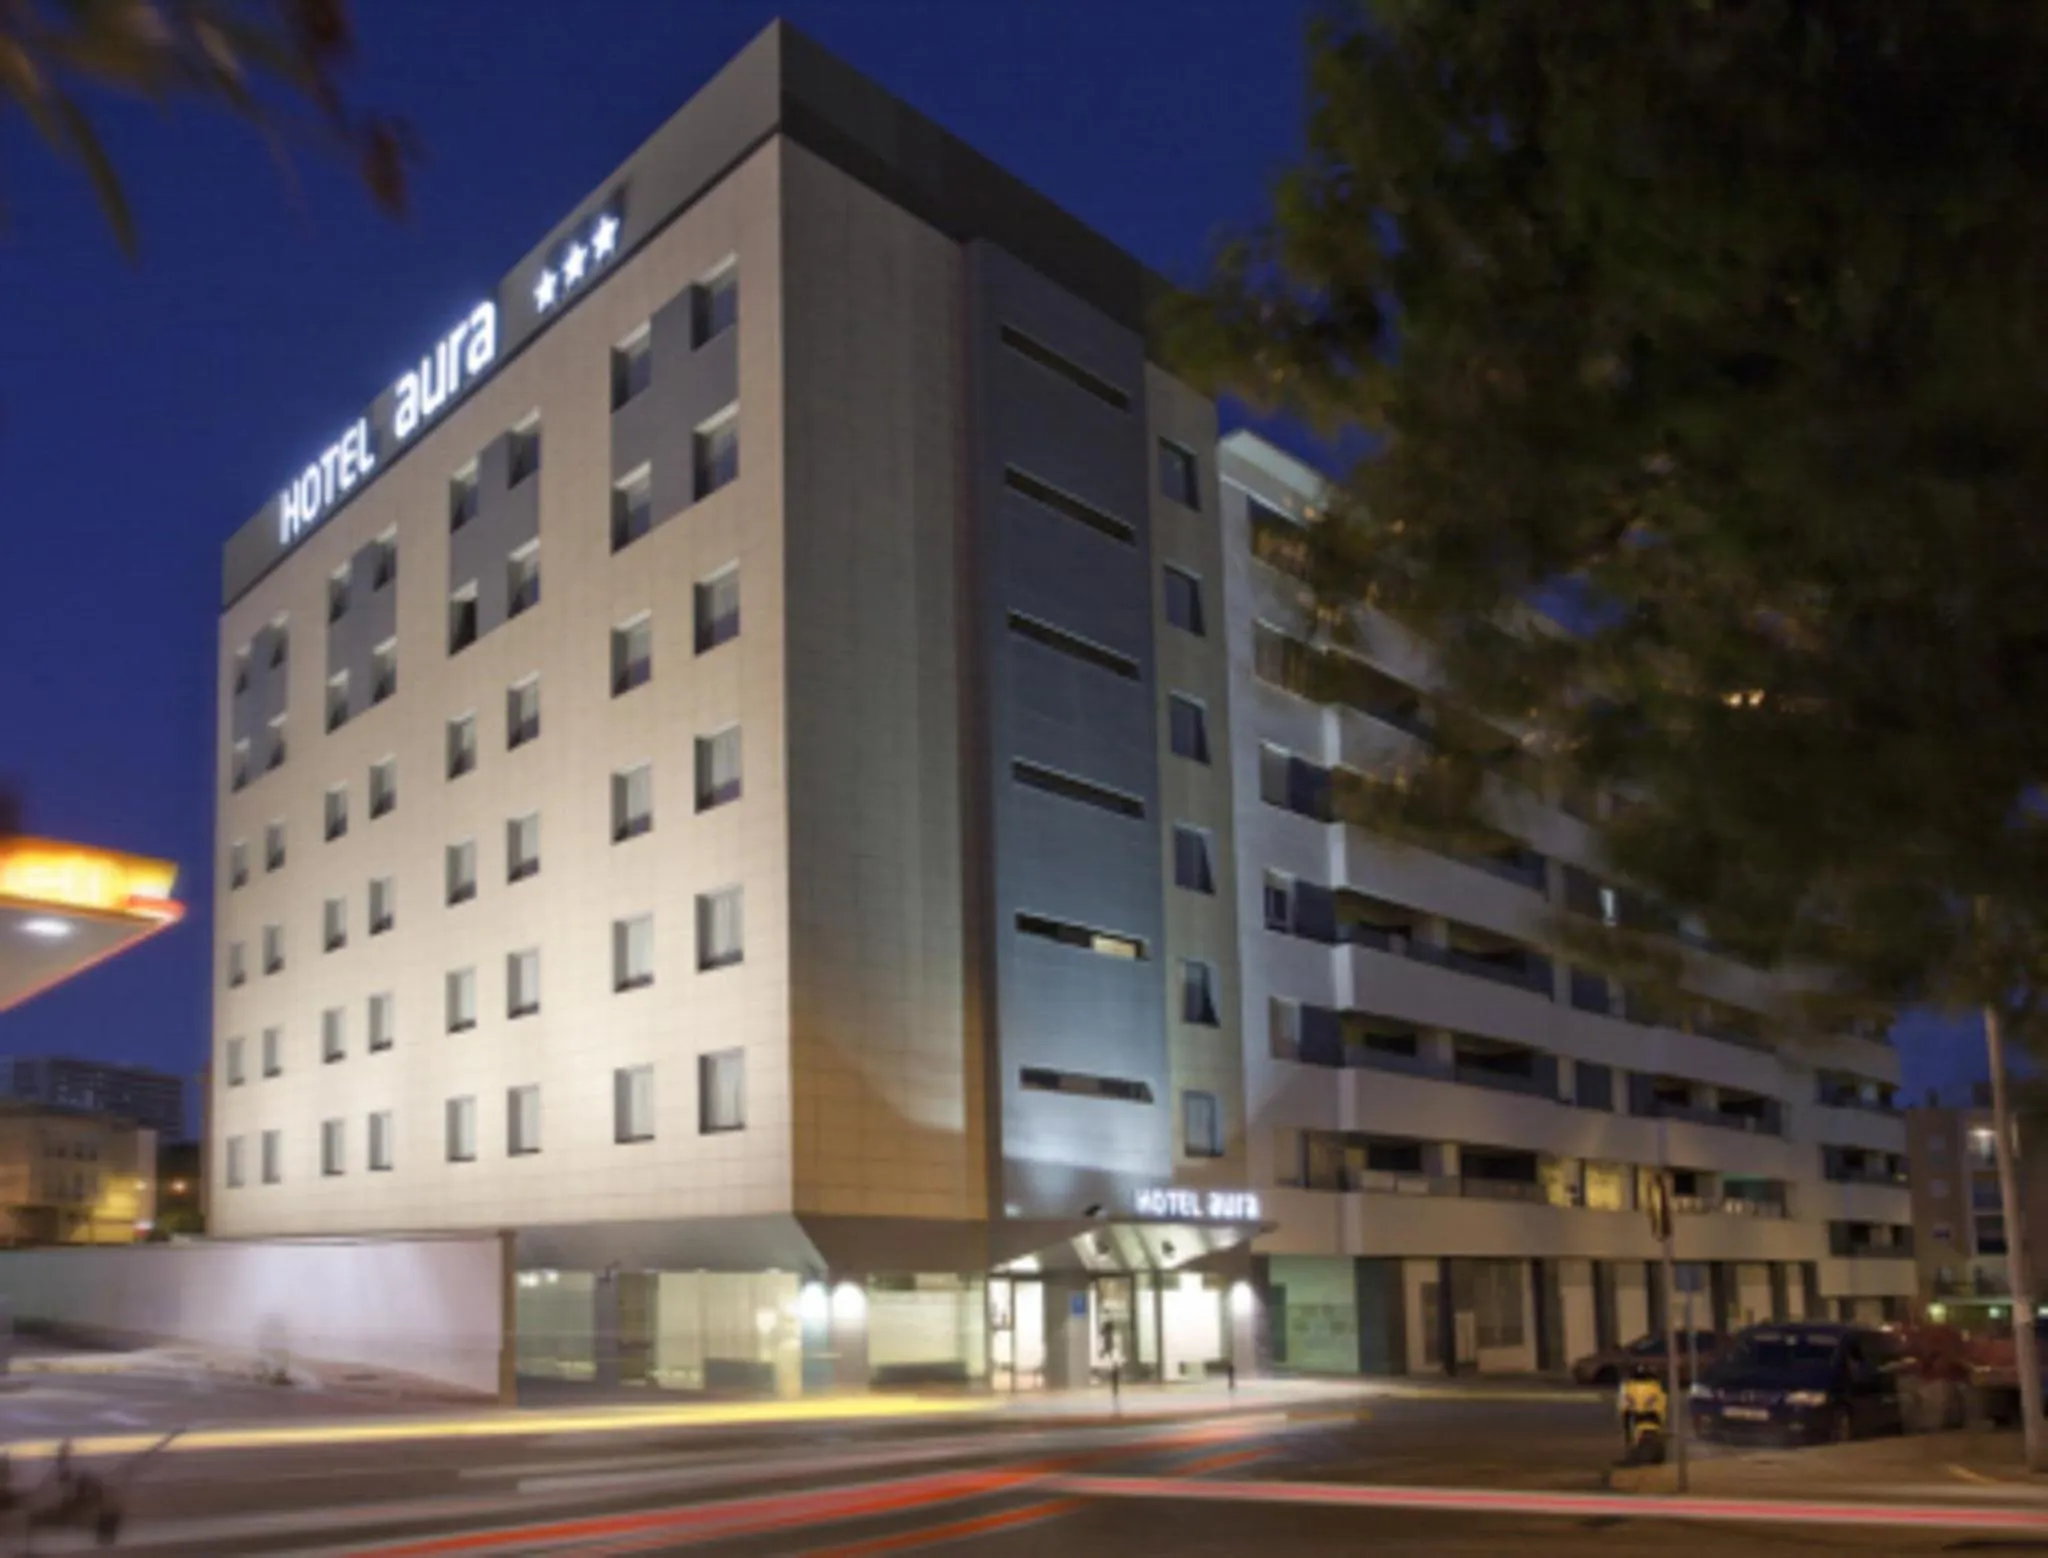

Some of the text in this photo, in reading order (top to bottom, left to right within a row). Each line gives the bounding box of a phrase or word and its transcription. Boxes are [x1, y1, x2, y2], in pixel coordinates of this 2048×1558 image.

[279, 300, 496, 544] HOTEL aura
[1135, 1188, 1203, 1217] HOTEL
